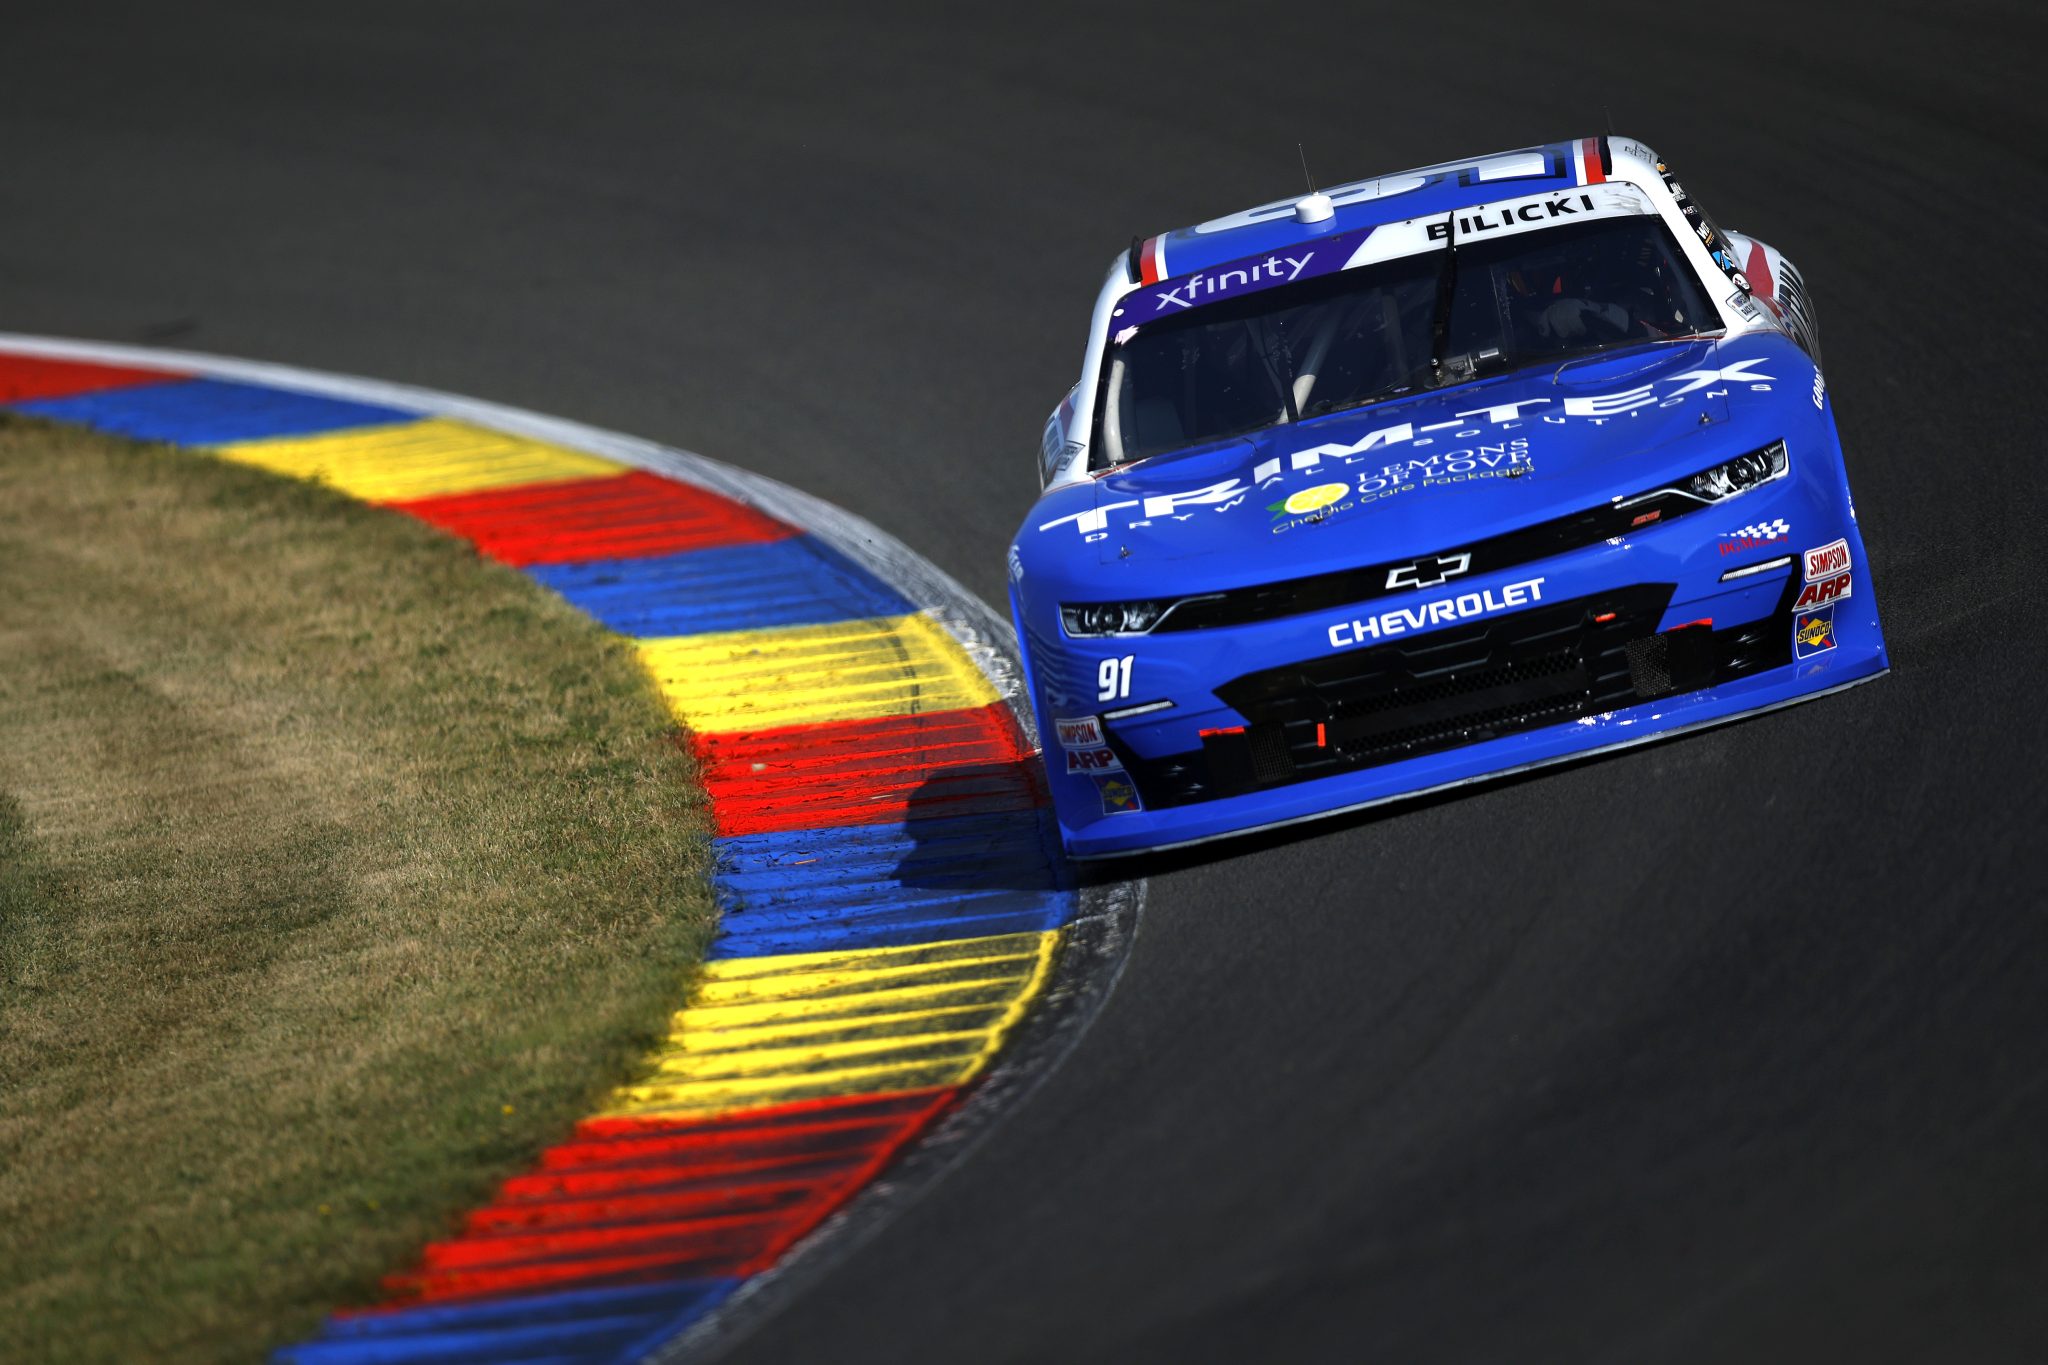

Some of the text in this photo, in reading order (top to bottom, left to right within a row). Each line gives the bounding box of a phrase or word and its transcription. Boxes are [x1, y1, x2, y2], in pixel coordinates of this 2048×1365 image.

[1427, 194, 1595, 241] BILICKI
[1156, 251, 1315, 310] xfinity
[1039, 357, 1777, 534] TRIM-TEX
[1085, 383, 1772, 543] DRYWALL SOLUTIONS
[1356, 437, 1529, 483] LEMONS
[1358, 470, 1409, 493] OF
[1360, 483, 1415, 504] Care
[1810, 544, 1847, 575] SIMPSON
[1328, 577, 1545, 648] CHEVROLET
[1797, 573, 1851, 607] ARP
[1799, 621, 1831, 642] SUNOCO
[1098, 655, 1135, 702] 91
[1068, 750, 1114, 769] ARP
